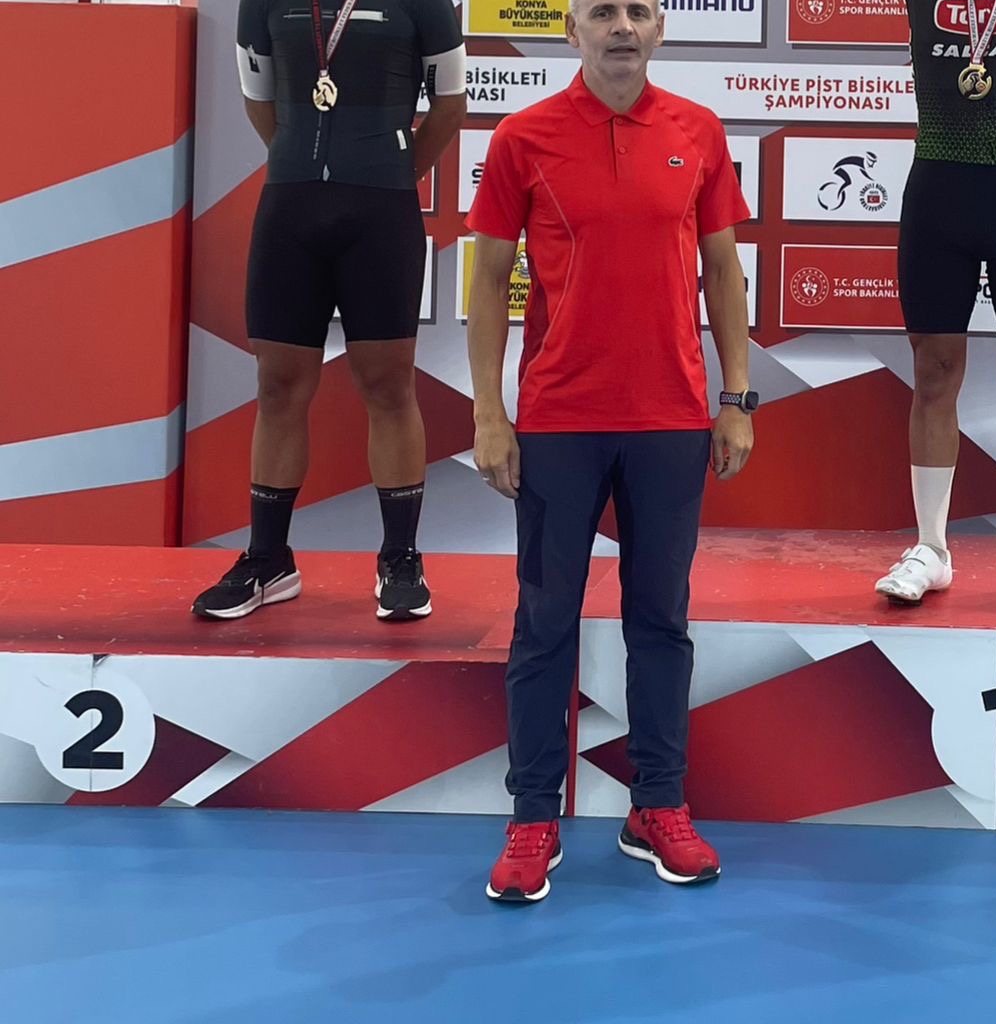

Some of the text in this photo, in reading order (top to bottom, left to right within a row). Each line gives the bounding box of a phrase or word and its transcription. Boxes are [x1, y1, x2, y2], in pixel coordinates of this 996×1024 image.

[516, 0, 547, 8] KONYA
[499, 8, 563, 21] BÜYÜKŞEHİR
[839, 6, 908, 15] SPOR BAKANLI
[724, 74, 914, 94] TÜRKİYE PİST BİSİKLE
[765, 92, 890, 111] ŞAMPİYONASI
[852, 278, 894, 288] GENÇLİK
[833, 289, 857, 297] SPOR
[62, 689, 124, 770] 2
